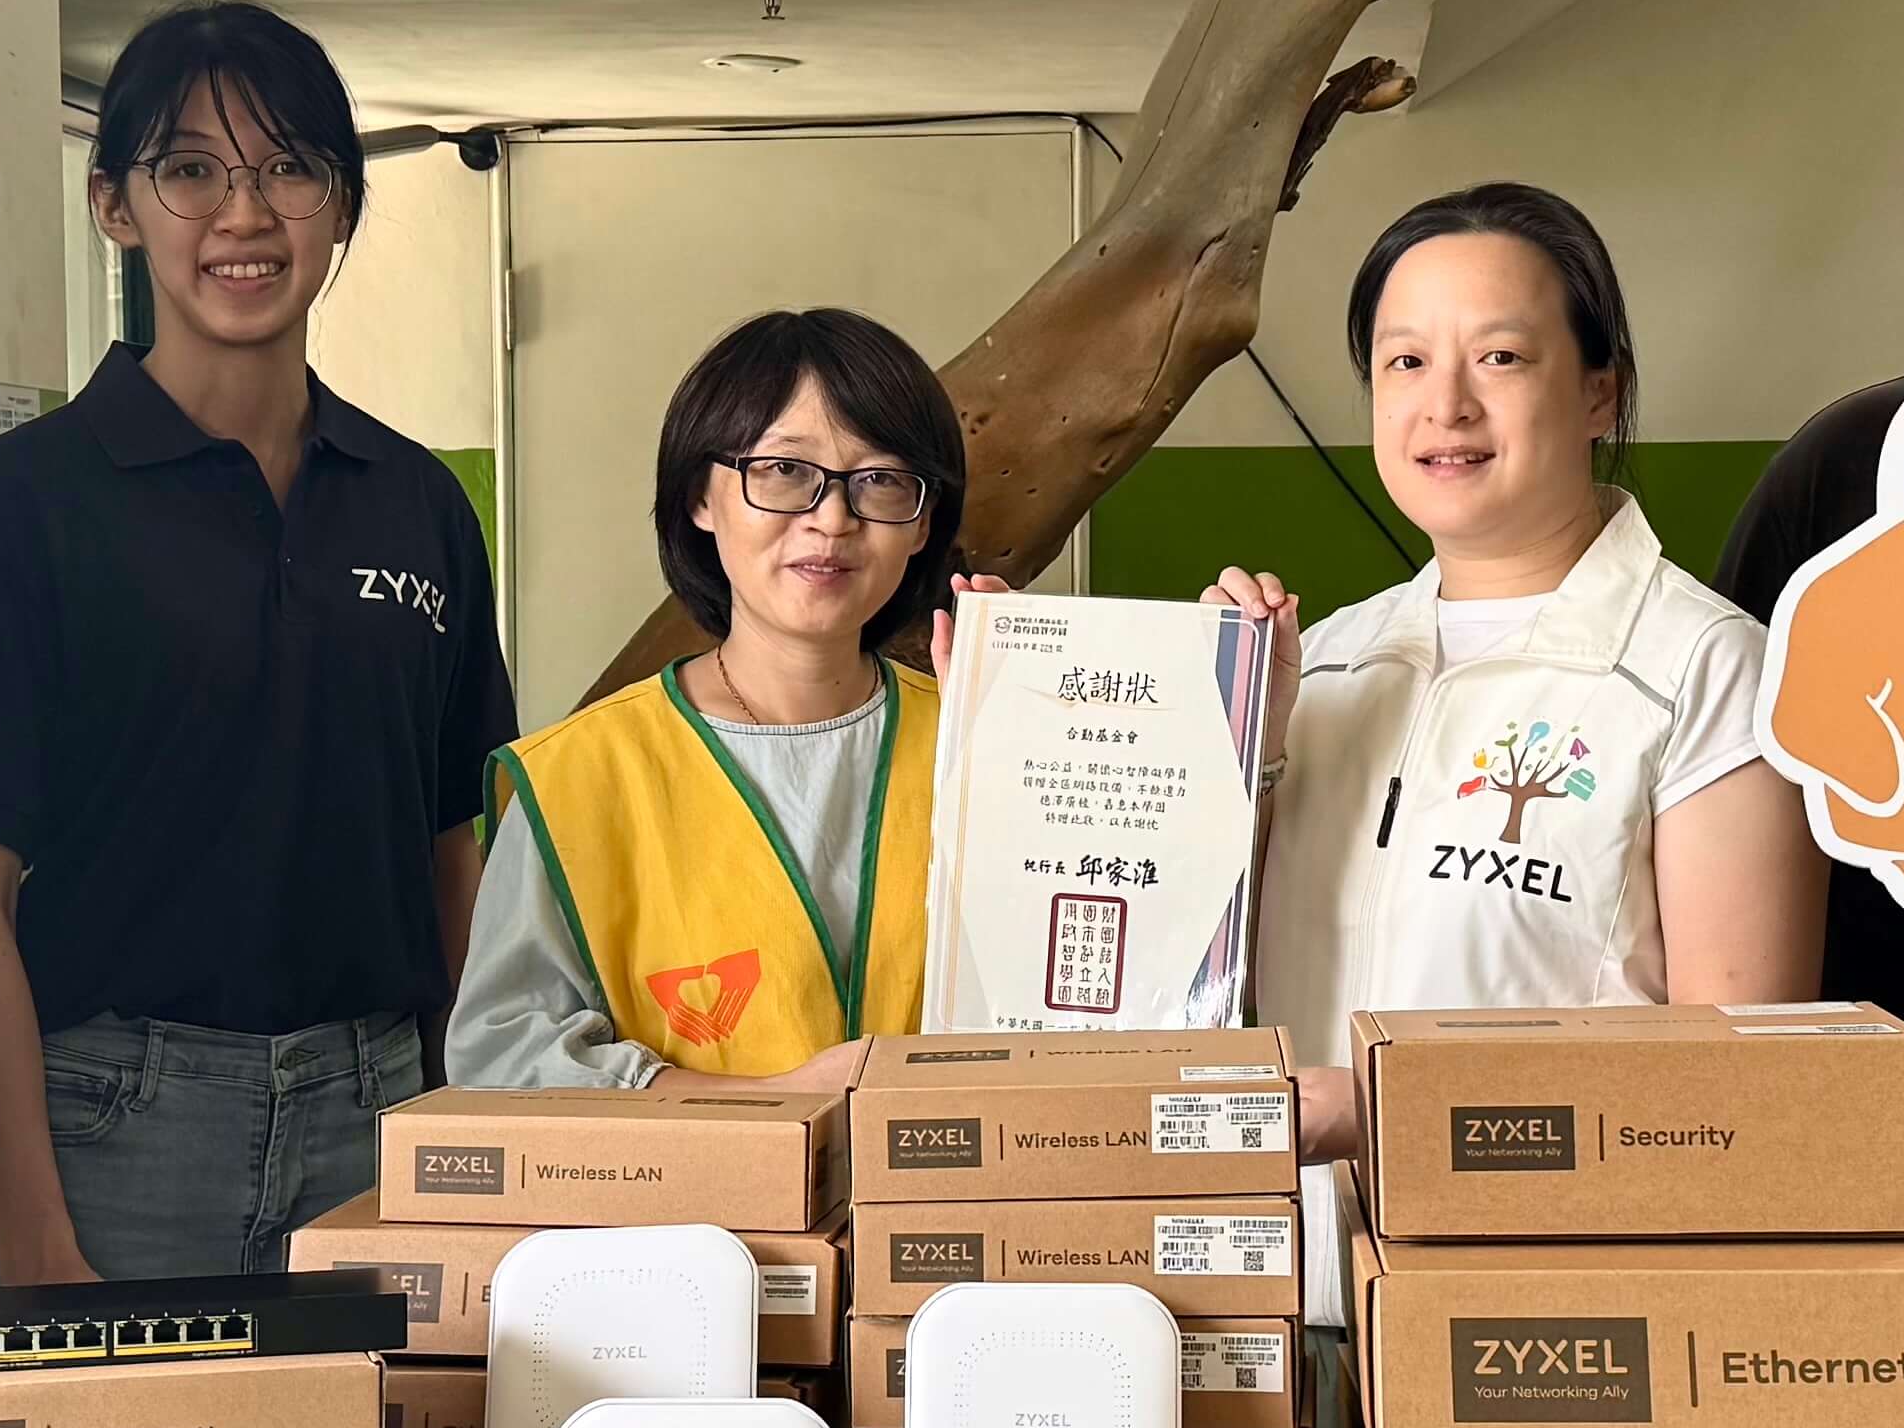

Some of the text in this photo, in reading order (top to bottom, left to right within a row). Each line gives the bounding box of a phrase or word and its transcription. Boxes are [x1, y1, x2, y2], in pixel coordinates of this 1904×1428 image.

[351, 568, 446, 633] ZYXEL
[1056, 665, 1159, 705] 感謝狀
[1427, 843, 1574, 906] ZYXEL
[897, 1128, 972, 1148] ZYXEL
[1015, 1130, 1148, 1149] Wireless LAN
[1464, 1119, 1563, 1145] ZYXEL
[1618, 1122, 1736, 1153] Security
[425, 1155, 496, 1175] ZYXEL
[536, 1164, 663, 1183] Wireless LAN
[900, 1244, 975, 1262] ZYXEL
[1017, 1249, 1150, 1266] Wireless LAN
[592, 1346, 648, 1361] ZYXEL
[1473, 1339, 1628, 1376] ZYXEL
[1474, 1383, 1630, 1403] Your Networking Ally
[1015, 1412, 1071, 1428] ZYXEL
